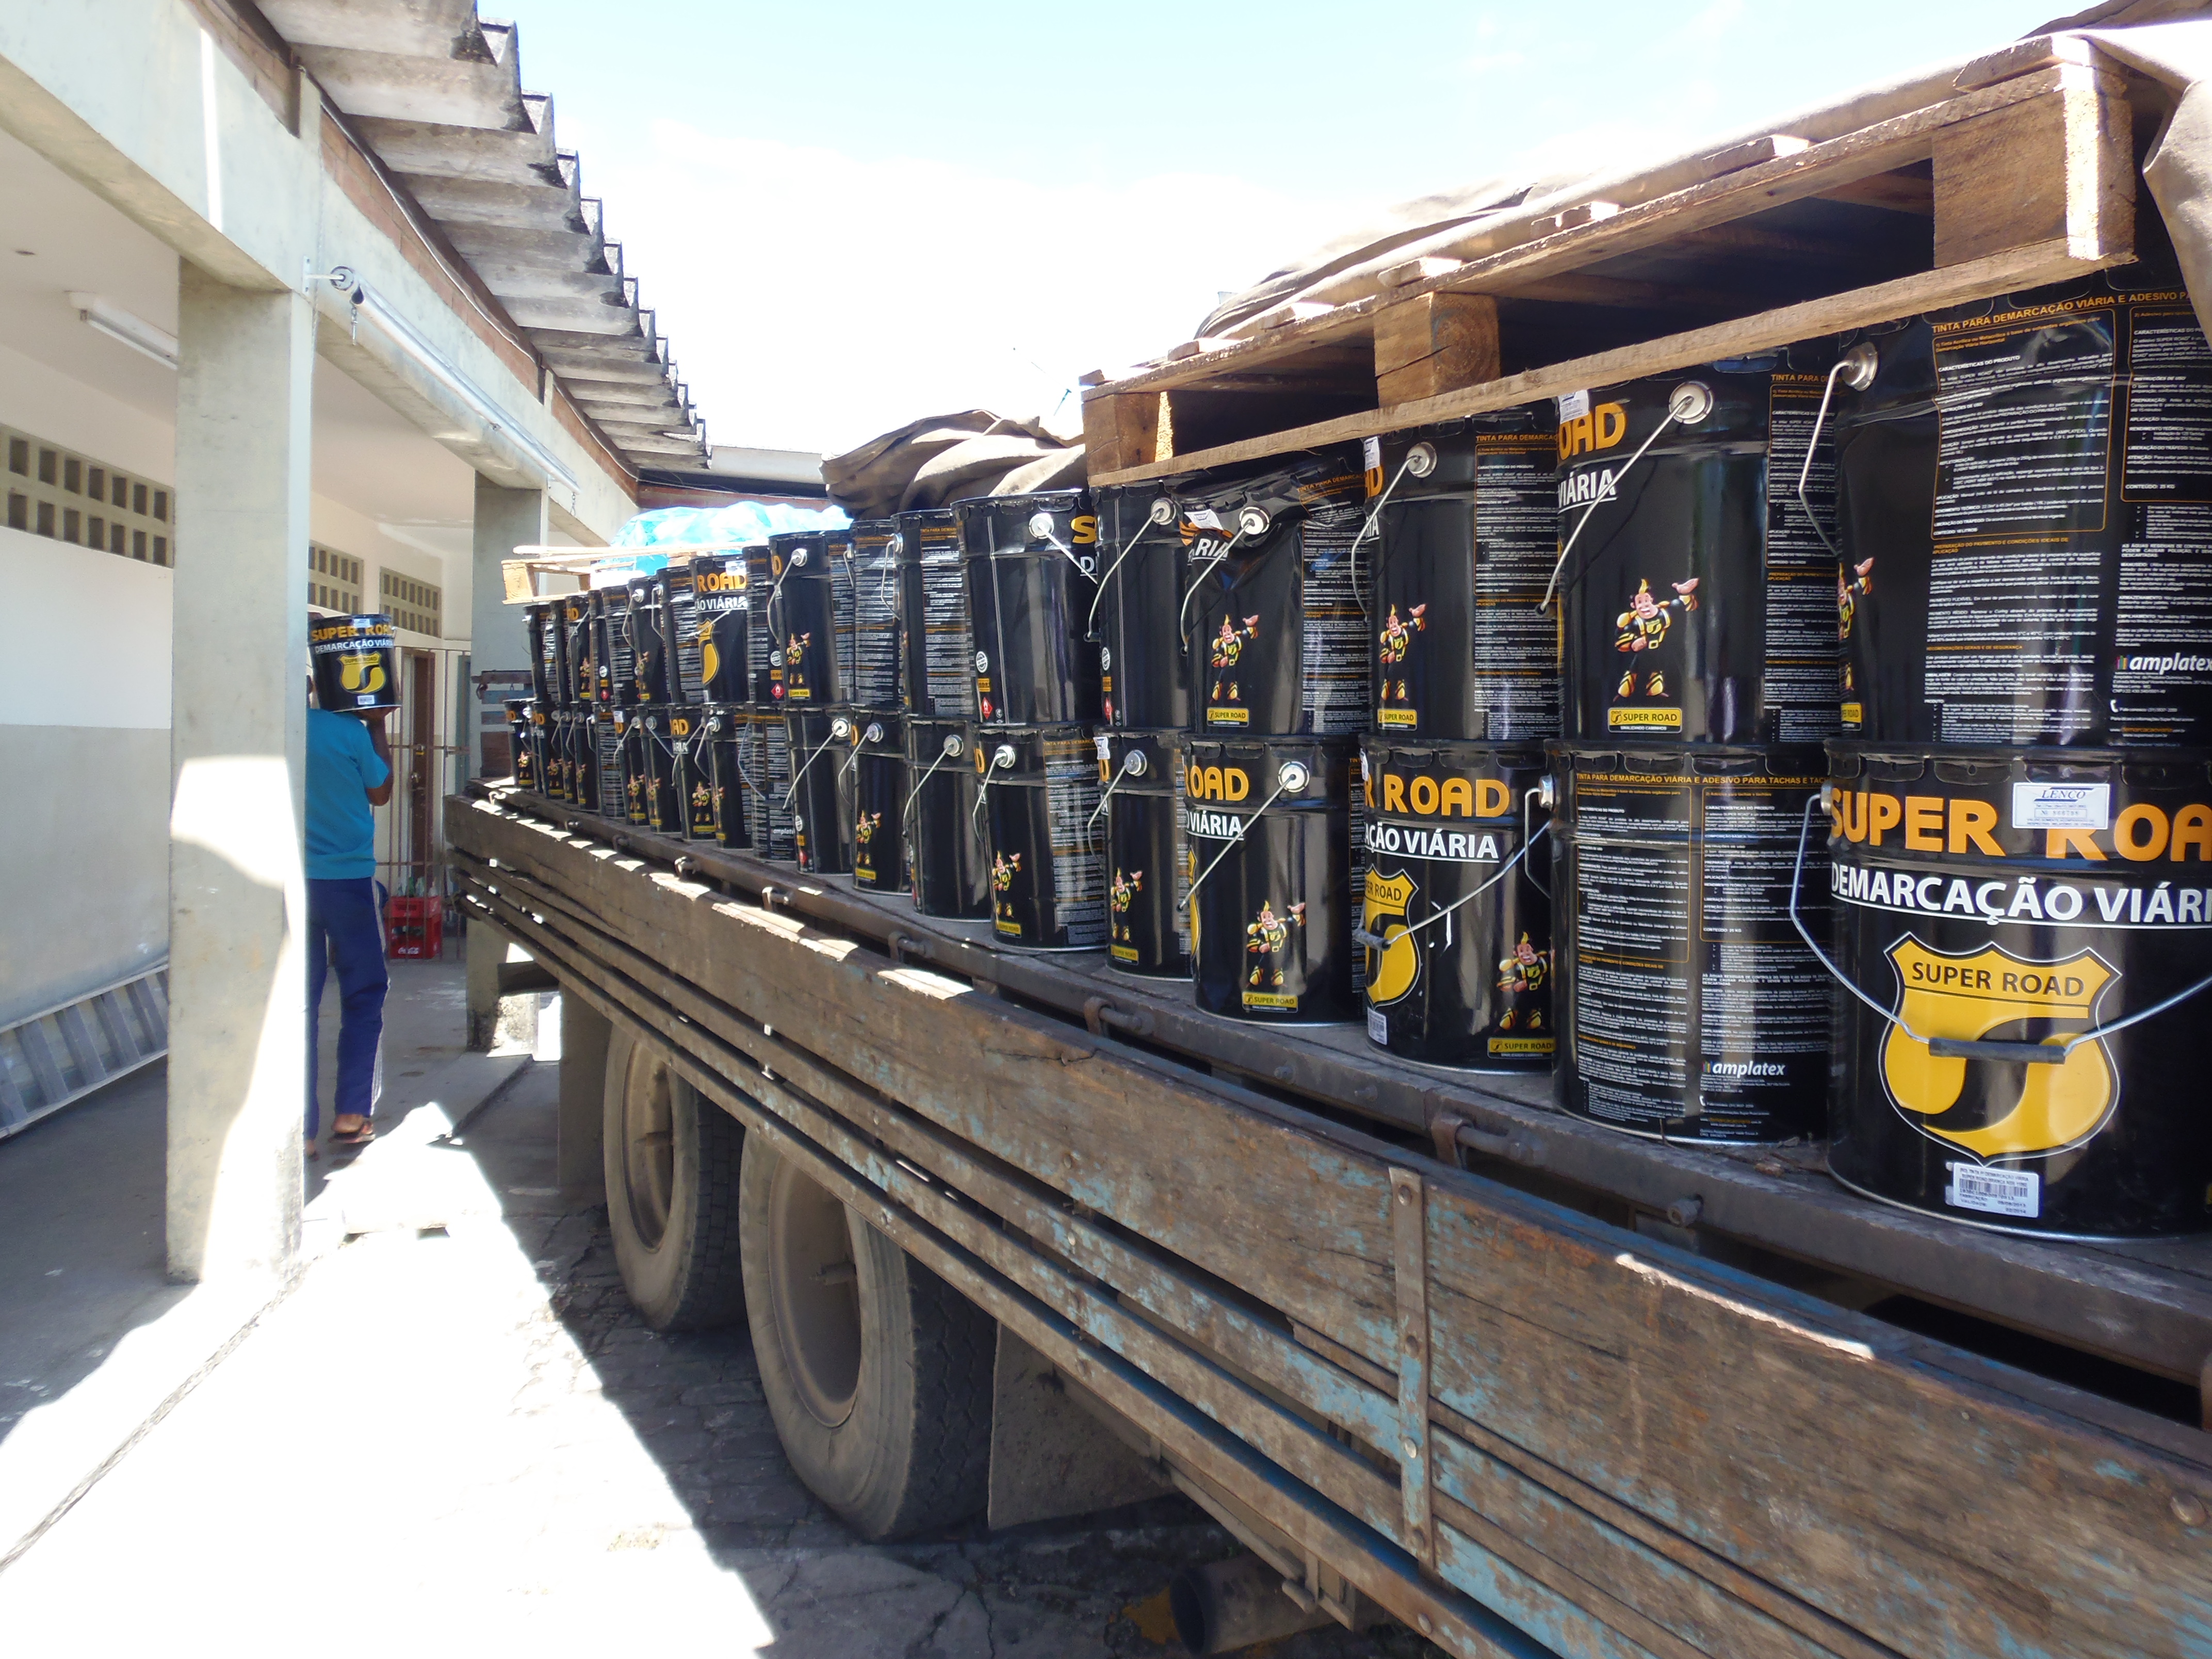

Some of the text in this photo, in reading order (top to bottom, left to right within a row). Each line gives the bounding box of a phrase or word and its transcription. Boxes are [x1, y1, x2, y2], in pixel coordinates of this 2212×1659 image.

[1932, 322, 1960, 334] TINTA
[1962, 316, 1991, 329] PARA
[1993, 301, 2074, 323] DEMARCAÇÃO
[2076, 296, 2115, 308] VIÁRIA
[2118, 295, 2126, 303] E
[2128, 291, 2177, 302] ADESIVO
[1994, 354, 2021, 364] PRODUTO
[1559, 402, 1628, 460] OAD
[1558, 468, 1617, 509] VIÁRIA
[1195, 538, 1229, 558] RIA
[697, 572, 747, 592] ROAD
[706, 595, 748, 610] VIÁRIA
[311, 626, 360, 642] SUPER
[315, 639, 374, 654] DEMARCAÇÃO
[2129, 652, 2212, 675] amplatex
[1652, 713, 1678, 722] ROAD
[1609, 774, 1662, 784] DEMARCAÇÃO
[1664, 775, 1692, 784] VIÁRIA
[1384, 774, 1510, 818] ROAD
[2041, 790, 2086, 800] LENCO
[1190, 810, 1244, 837] VIÁRIA
[1831, 787, 2212, 863] SUPER ROA
[1403, 827, 1499, 859] VIÁRIA
[1375, 883, 1403, 902] ROAD
[1832, 861, 2212, 925] DEMARCAÇÃO VIÁRI
[1911, 962, 2085, 998] SUPER ROAD
[1712, 1060, 1786, 1079] amplatex
